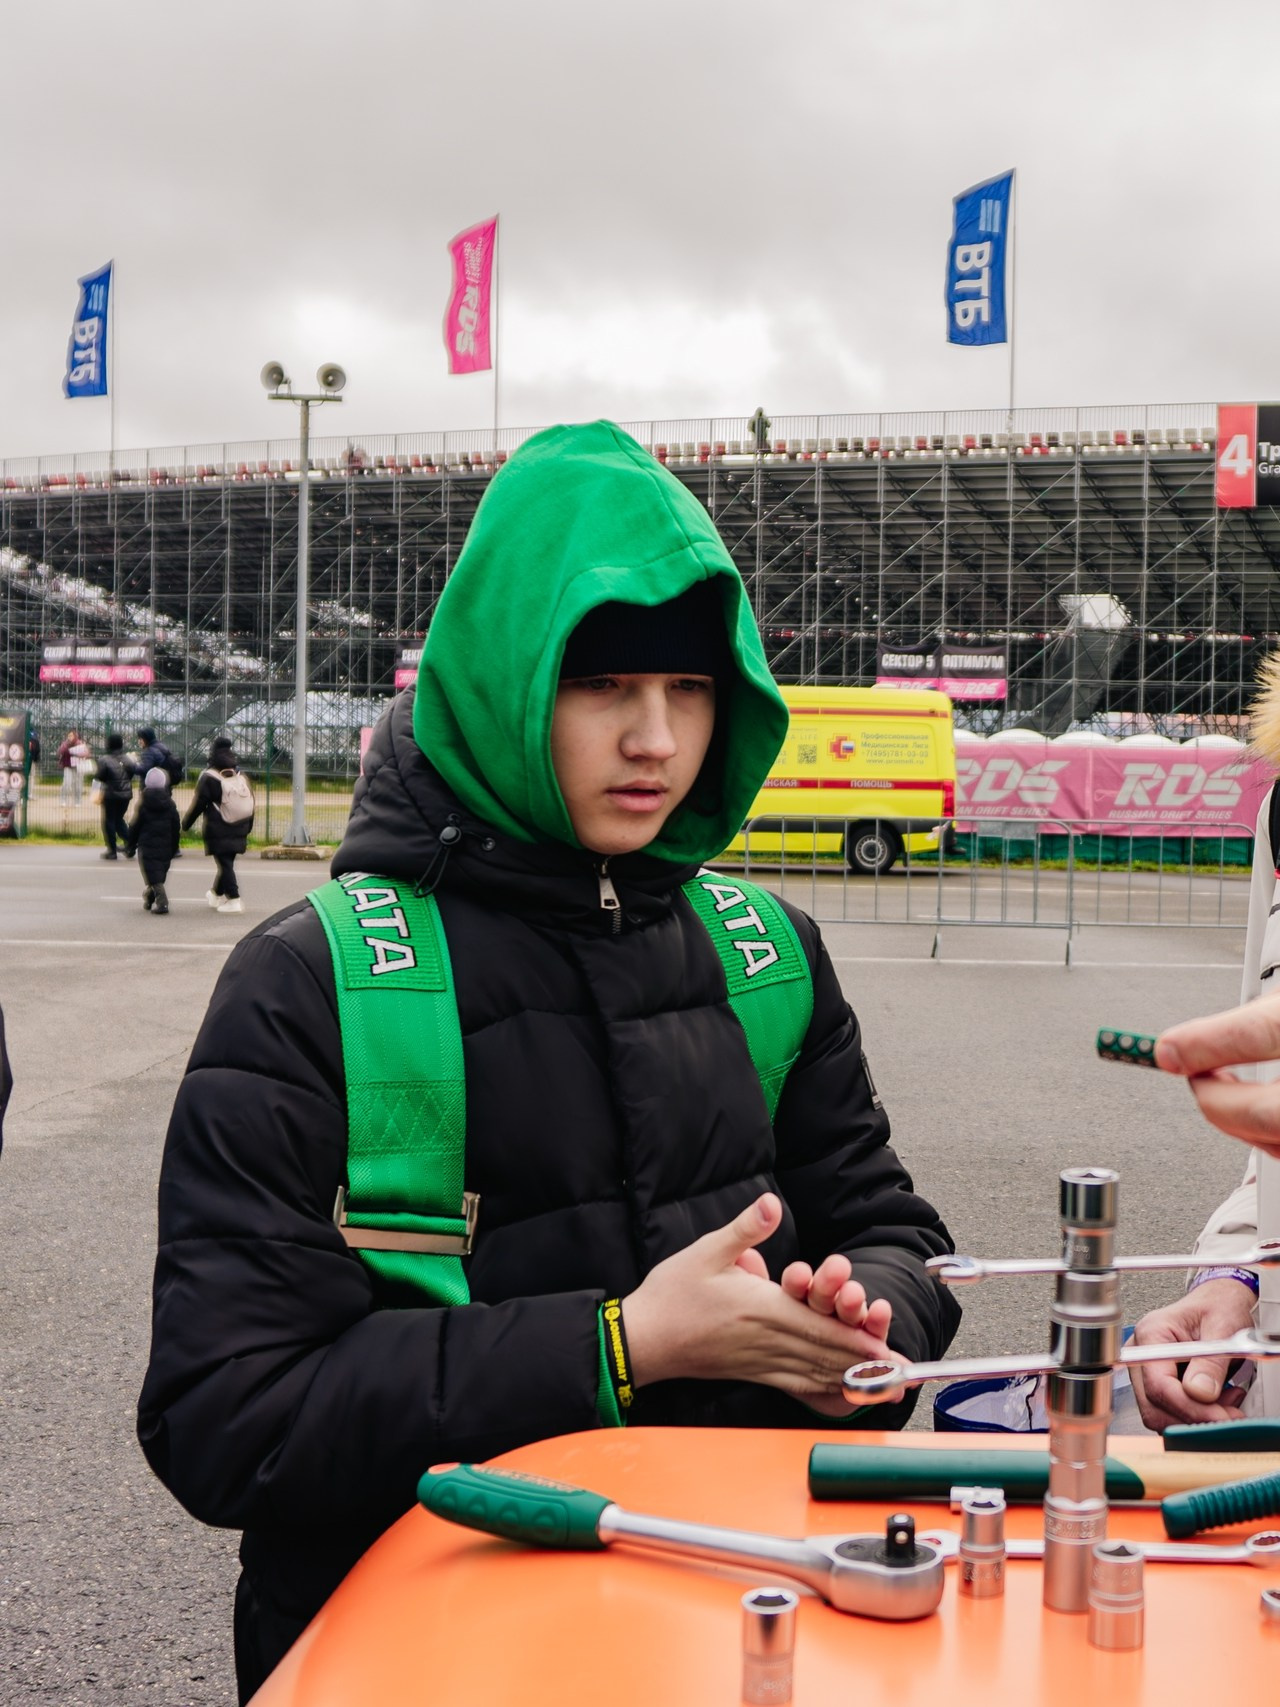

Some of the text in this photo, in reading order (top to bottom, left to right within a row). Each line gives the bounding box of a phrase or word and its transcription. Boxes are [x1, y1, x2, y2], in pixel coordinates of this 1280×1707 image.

[954, 241, 992, 328] ВТБ
[69, 316, 99, 382] ВТБ
[1219, 434, 1252, 477] 4
[881, 653, 935, 670] СЕКТОР 5
[942, 654, 1005, 669] ОПТИМУМ
[850, 780, 893, 789] ПОМОЩЬ
[1114, 763, 1252, 806] RDS
[975, 806, 1008, 815] DRIFT
[1010, 807, 1049, 816] SERIES
[1108, 809, 1233, 820] RUSSIAN DRIFT SERIES
[608, 1319, 628, 1381] JONNESWAY
